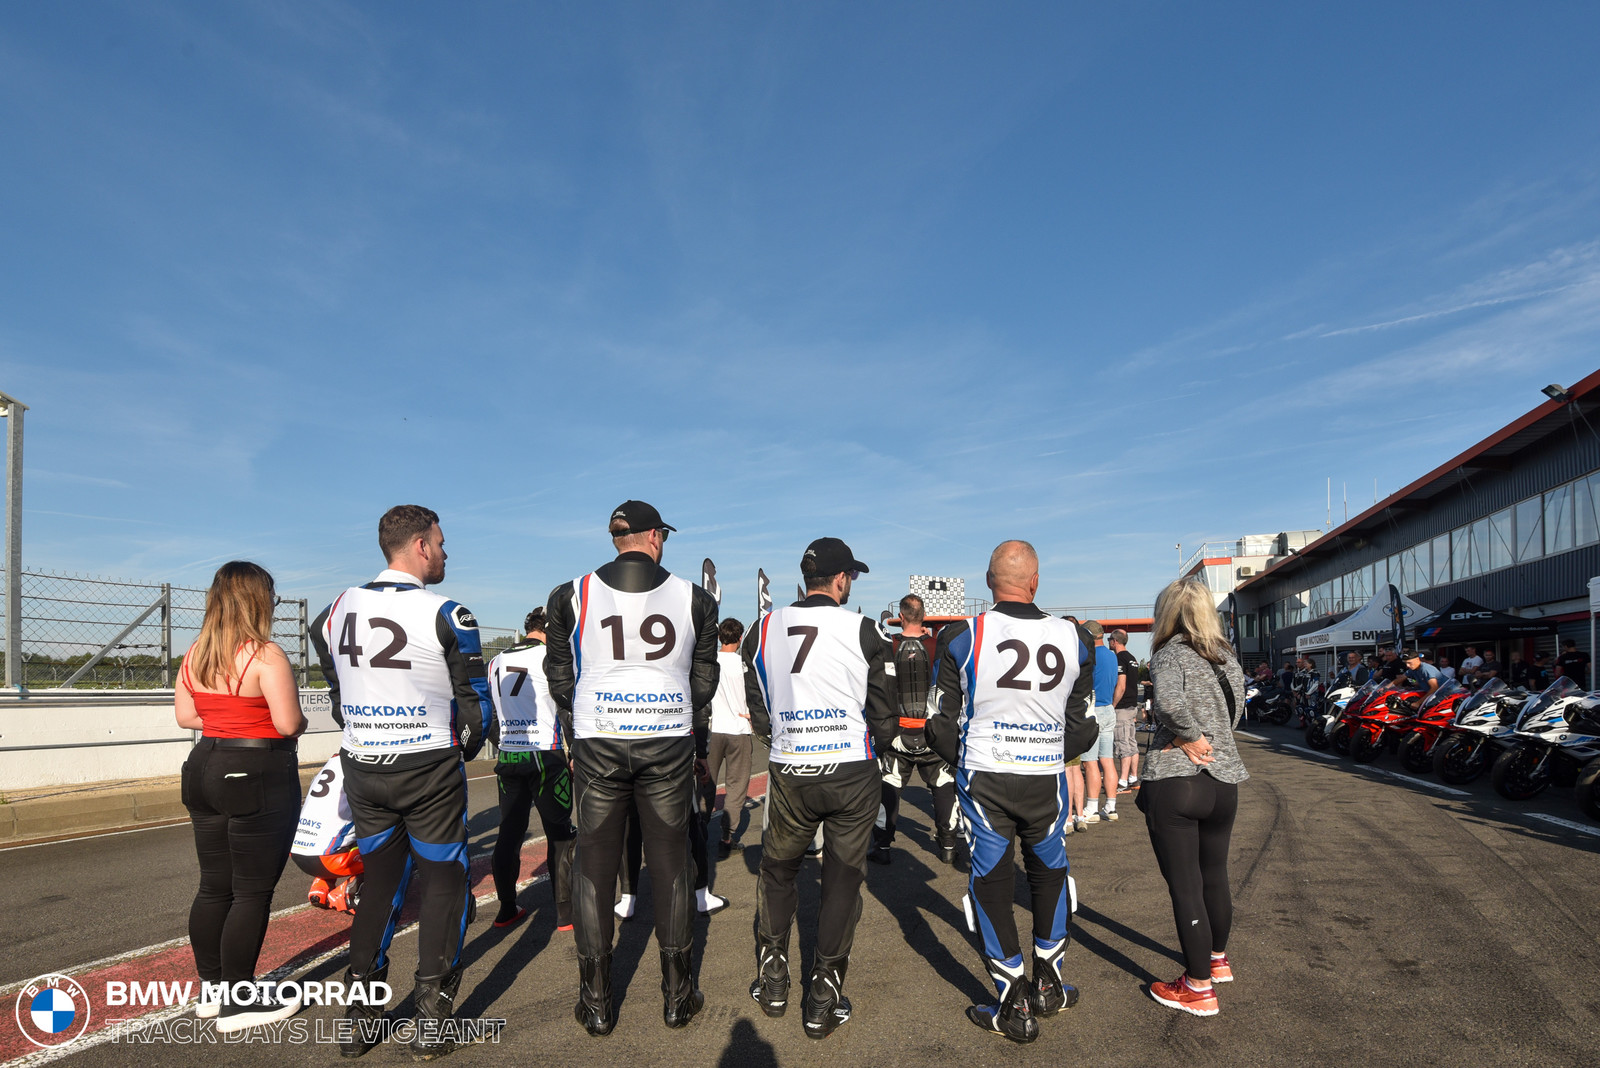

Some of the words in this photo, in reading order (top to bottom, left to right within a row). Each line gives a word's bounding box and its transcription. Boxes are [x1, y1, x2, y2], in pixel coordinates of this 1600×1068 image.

[1451, 611, 1493, 620] BMC
[338, 612, 412, 670] 42
[600, 613, 677, 661] 19
[787, 625, 819, 674] 7
[995, 638, 1066, 692] 29
[494, 665, 528, 698] 17
[594, 692, 684, 703] TRACKDAYS
[342, 704, 428, 717] TRACKDAYS
[635, 707, 684, 715] MOTORRAD
[778, 708, 848, 722] TRACKDAYS
[352, 722, 372, 730] BMW
[374, 721, 429, 730] MOTORRAD
[618, 722, 684, 732] MICHELIN
[805, 724, 848, 734] MOTORRAD
[362, 732, 432, 747] MICHELIN
[1004, 735, 1027, 743] BMW
[794, 741, 852, 753] MICHELIN
[1014, 753, 1063, 763] MICHELIN
